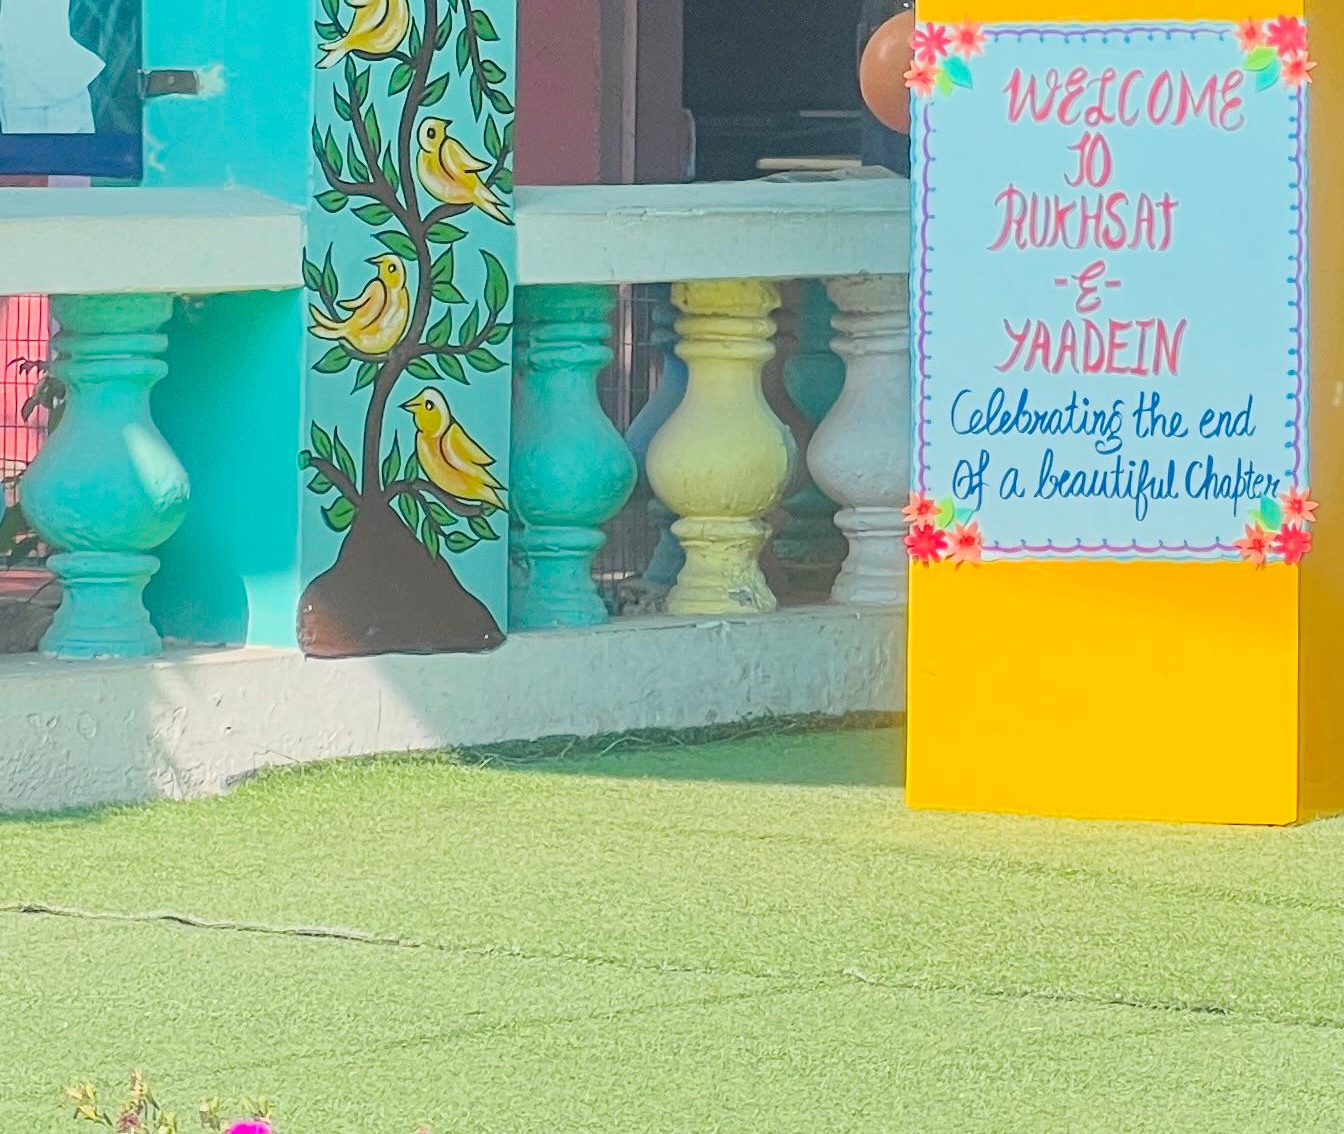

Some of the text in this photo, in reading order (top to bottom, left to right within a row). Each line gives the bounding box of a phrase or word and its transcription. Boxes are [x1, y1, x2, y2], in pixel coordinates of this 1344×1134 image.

[1003, 66, 1245, 131] WELCOME
[994, 317, 1188, 377] YAADEIN
[951, 387, 1256, 455] Celebrating the end
[1000, 466, 1025, 500] a
[1034, 447, 1179, 522] beautiful
[1185, 454, 1281, 517] Chapter
